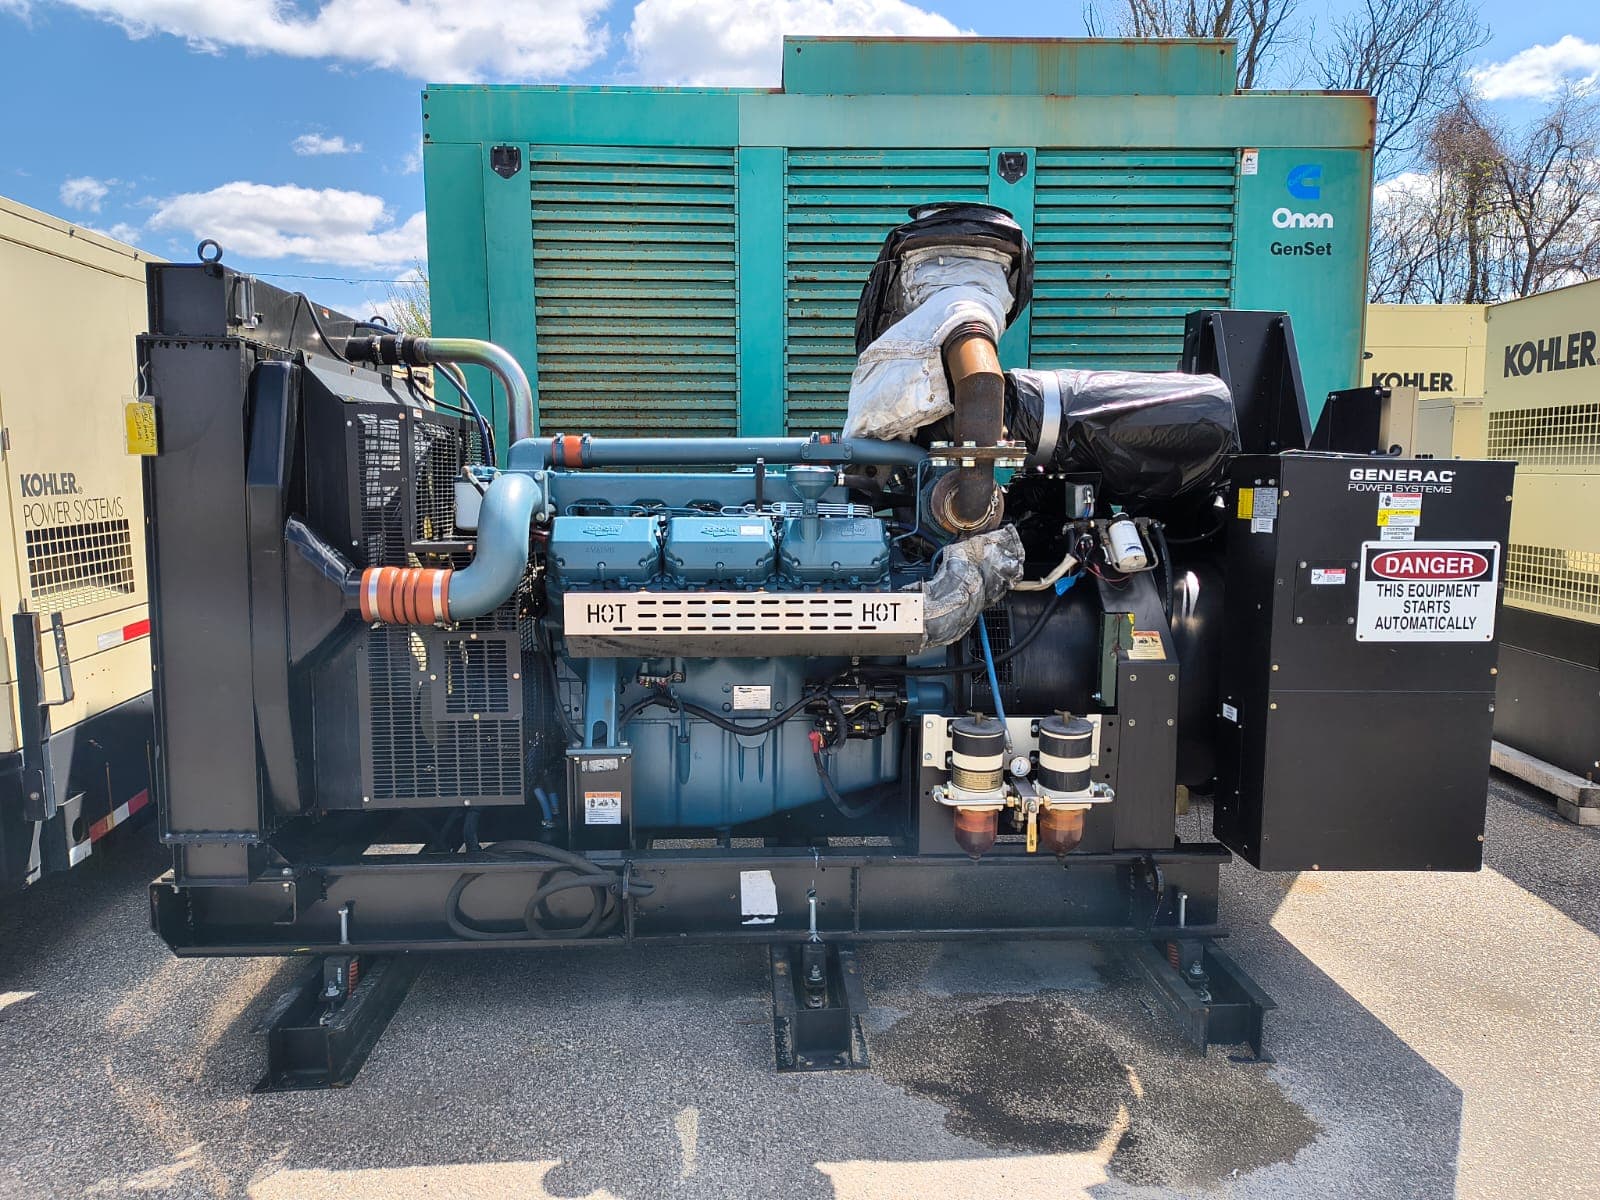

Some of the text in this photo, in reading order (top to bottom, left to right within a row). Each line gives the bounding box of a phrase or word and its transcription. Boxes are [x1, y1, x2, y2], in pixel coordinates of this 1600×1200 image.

[1272, 207, 1334, 229] Onan
[1270, 241, 1332, 256] GenSet
[1503, 330, 1597, 378] KOHLER
[1371, 372, 1454, 392] KOHLER
[20, 472, 78, 498] KOHLER
[1349, 468, 1453, 483] GENERAC
[1347, 483, 1453, 494] POWER SYSTEMS
[23, 496, 124, 528] POWER SYSTEMS
[1385, 556, 1475, 575] DANGER
[1377, 584, 1481, 598] THIS EQUIPMENT
[587, 602, 901, 624] HOT HOT
[1403, 600, 1451, 614] STARTS
[1374, 616, 1478, 630] AUTOMATICALLY
